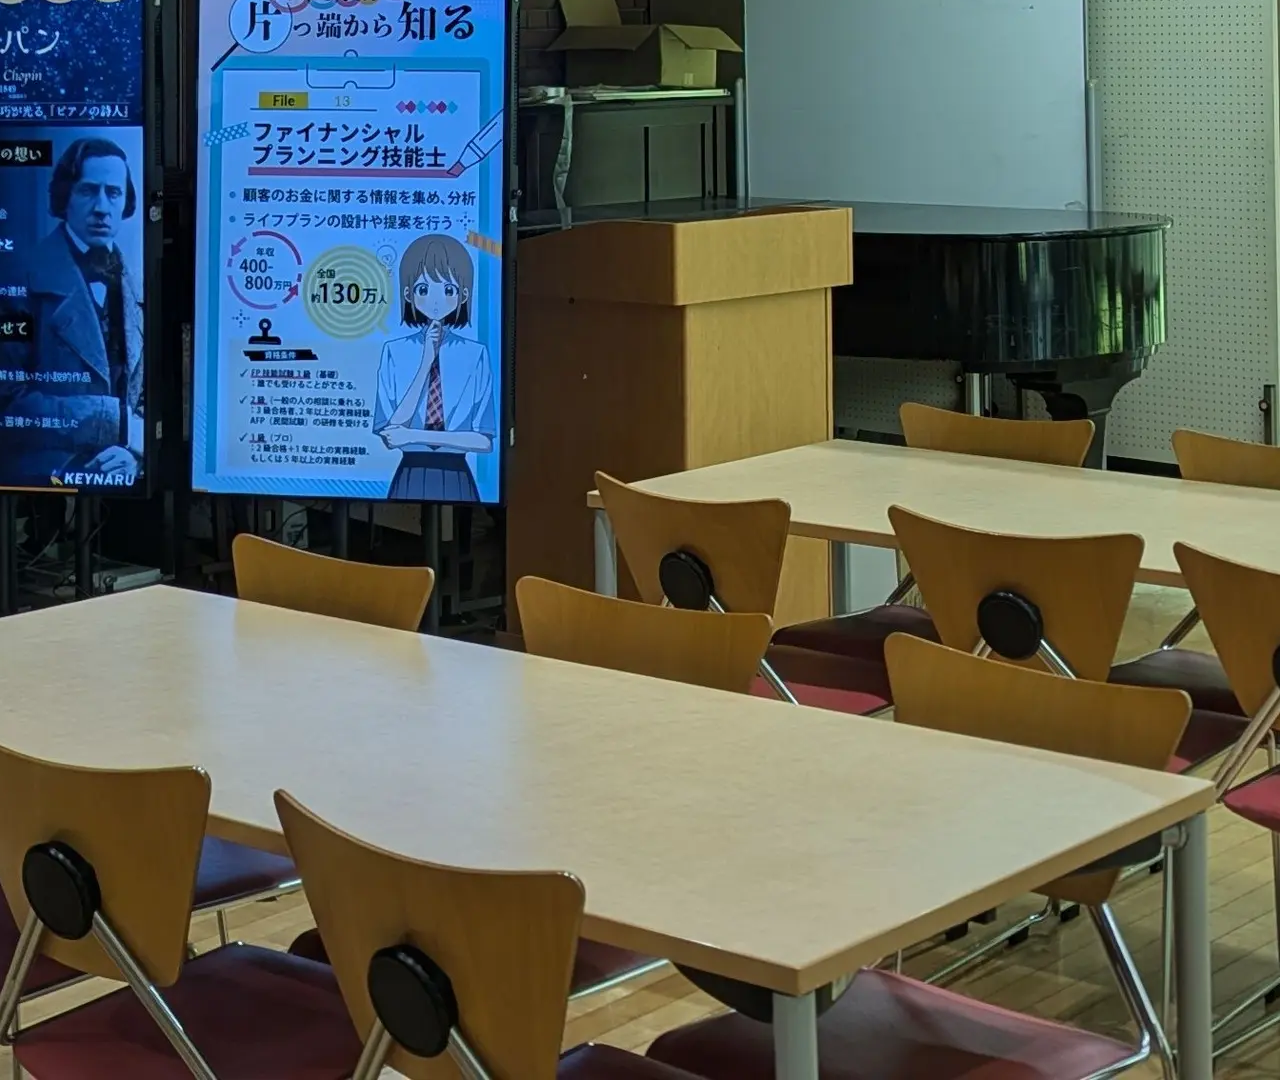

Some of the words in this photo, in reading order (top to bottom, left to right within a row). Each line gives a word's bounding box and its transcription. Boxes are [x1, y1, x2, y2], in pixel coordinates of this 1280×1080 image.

[243, 1, 475, 42] 片っ端から知る
[3, 69, 43, 87] Chopin
[272, 94, 296, 108] File
[334, 95, 351, 108] 13
[253, 122, 425, 144] ファイナンシャル
[253, 145, 447, 168] プランニング技能士
[243, 188, 476, 206] 顧客のお金に関する情報を集め、分析
[243, 212, 453, 231] ライフプランの設計や提案を行う
[256, 247, 275, 257] 年収
[245, 275, 292, 290] 800万円
[317, 268, 336, 279] 全国
[311, 282, 388, 304] 約130万人
[64, 472, 135, 486] KEYNARU
